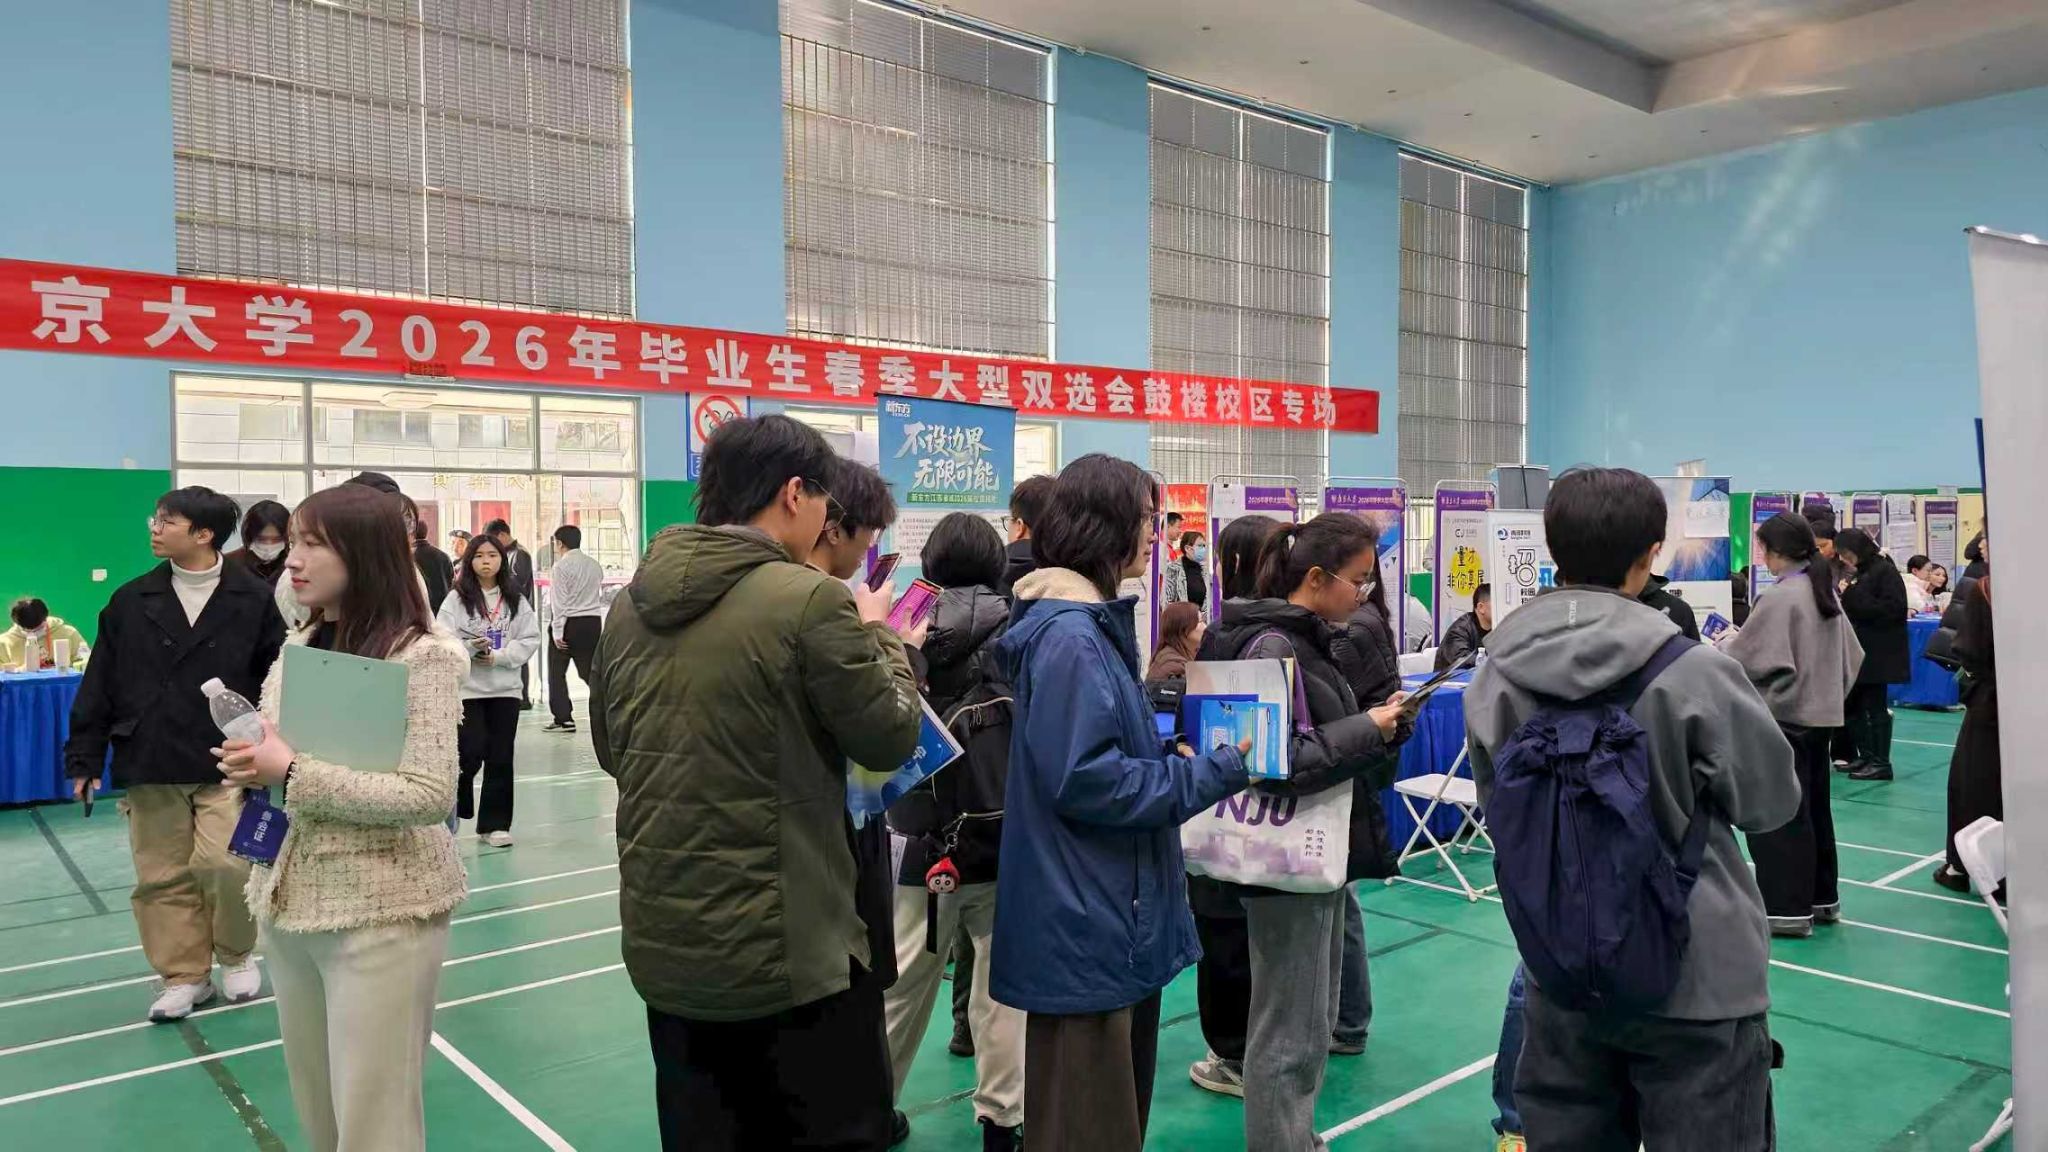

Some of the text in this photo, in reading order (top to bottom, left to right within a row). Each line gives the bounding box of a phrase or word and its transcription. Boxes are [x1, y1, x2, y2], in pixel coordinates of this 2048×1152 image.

[30, 276, 1338, 428] 京大学2026年毕业生春季大型双选会鼓楼校区专场
[894, 420, 993, 461] 不设边界
[912, 457, 1001, 493] 无限可能
[1214, 794, 1298, 827] NJU
